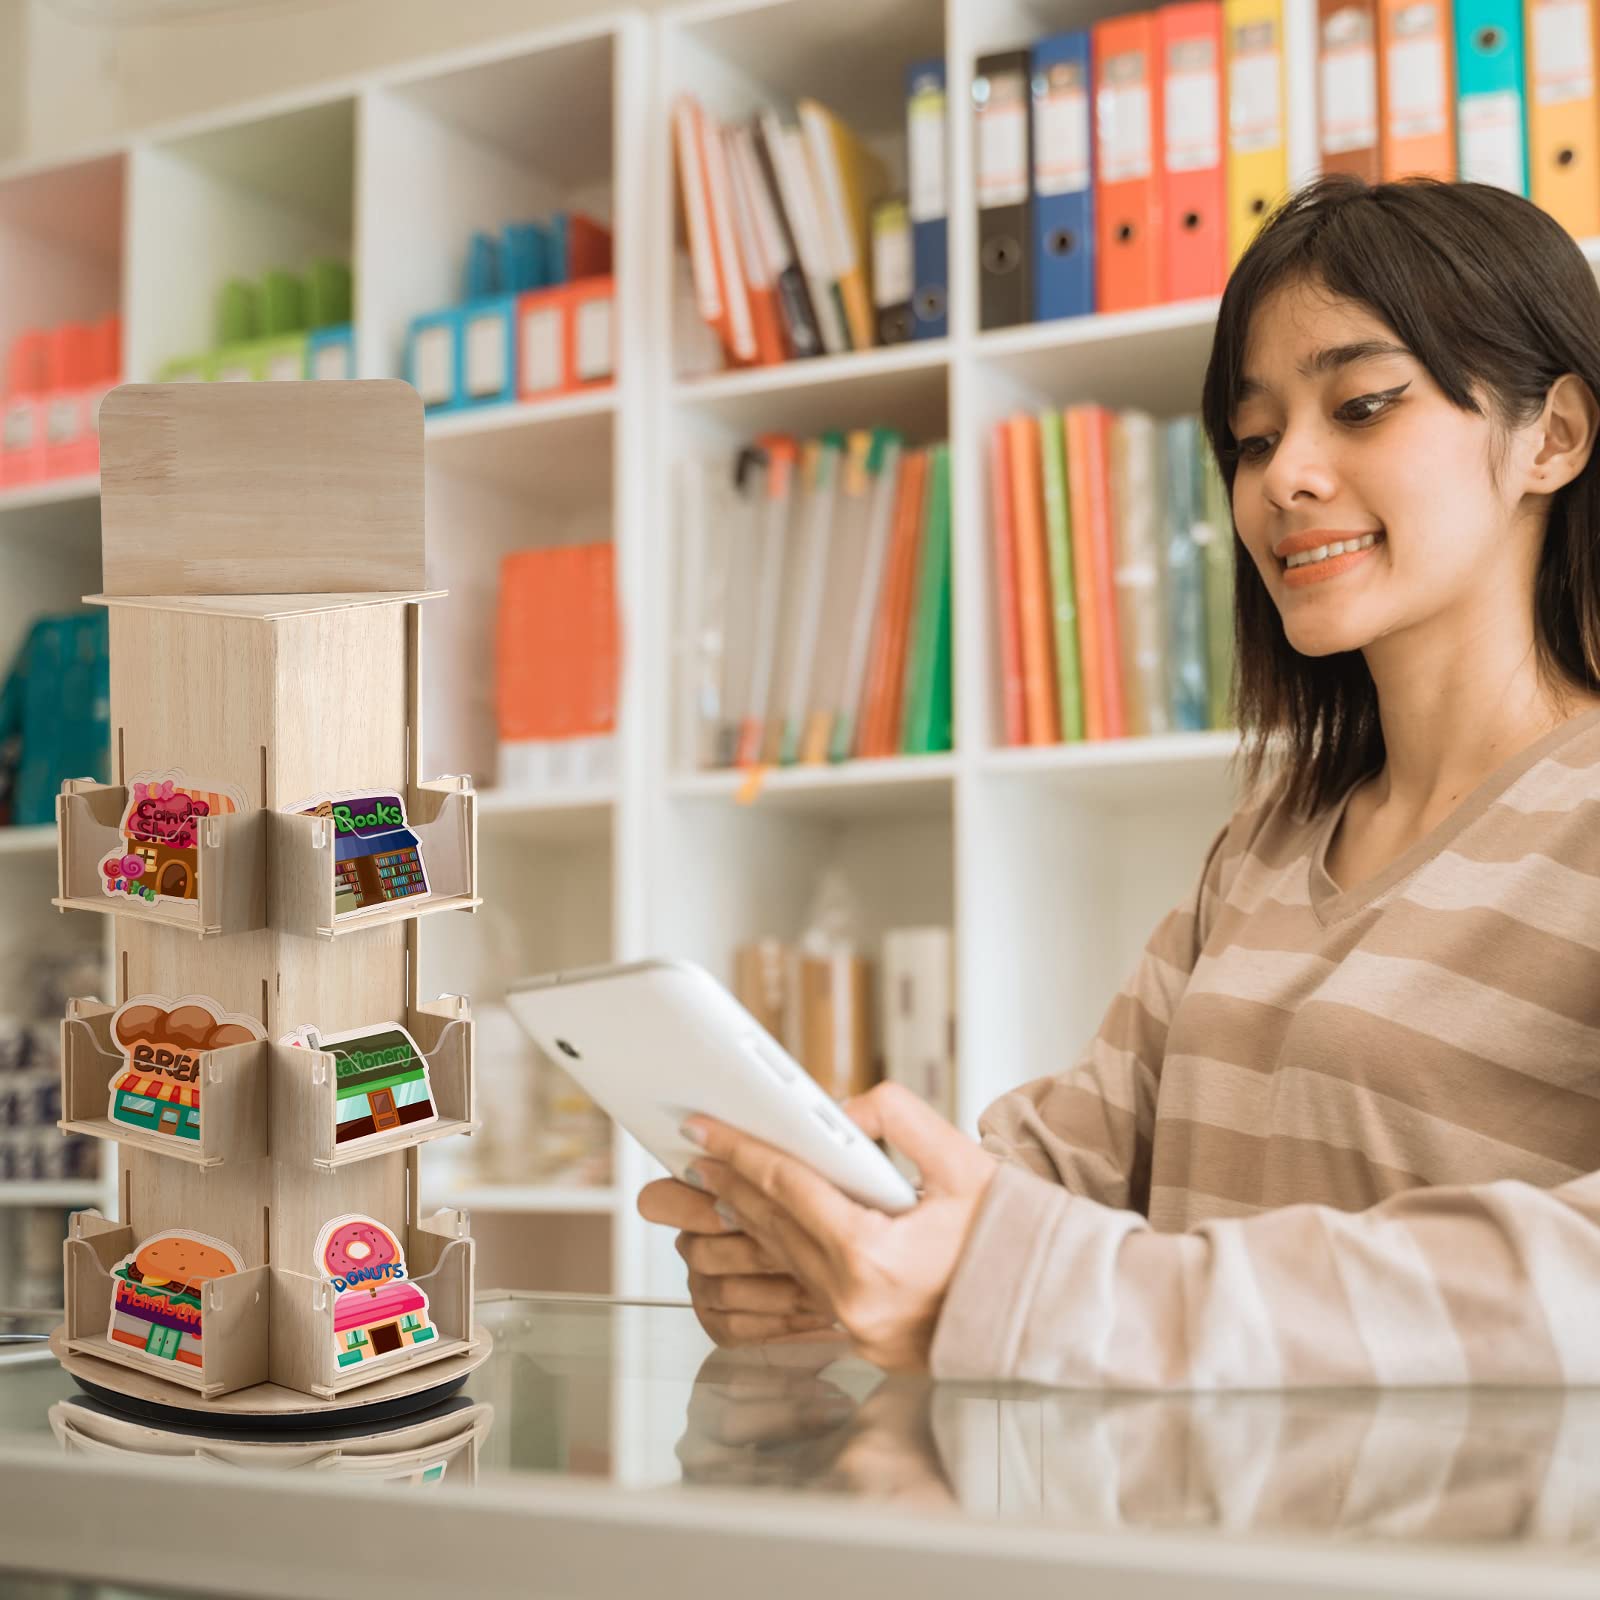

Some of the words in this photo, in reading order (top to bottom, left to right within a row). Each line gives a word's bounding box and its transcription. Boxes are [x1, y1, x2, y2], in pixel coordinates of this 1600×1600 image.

[137, 799, 209, 830] Candy
[332, 801, 404, 833] Books
[134, 820, 191, 846] Shop
[330, 1263, 404, 1293] DONUTS
